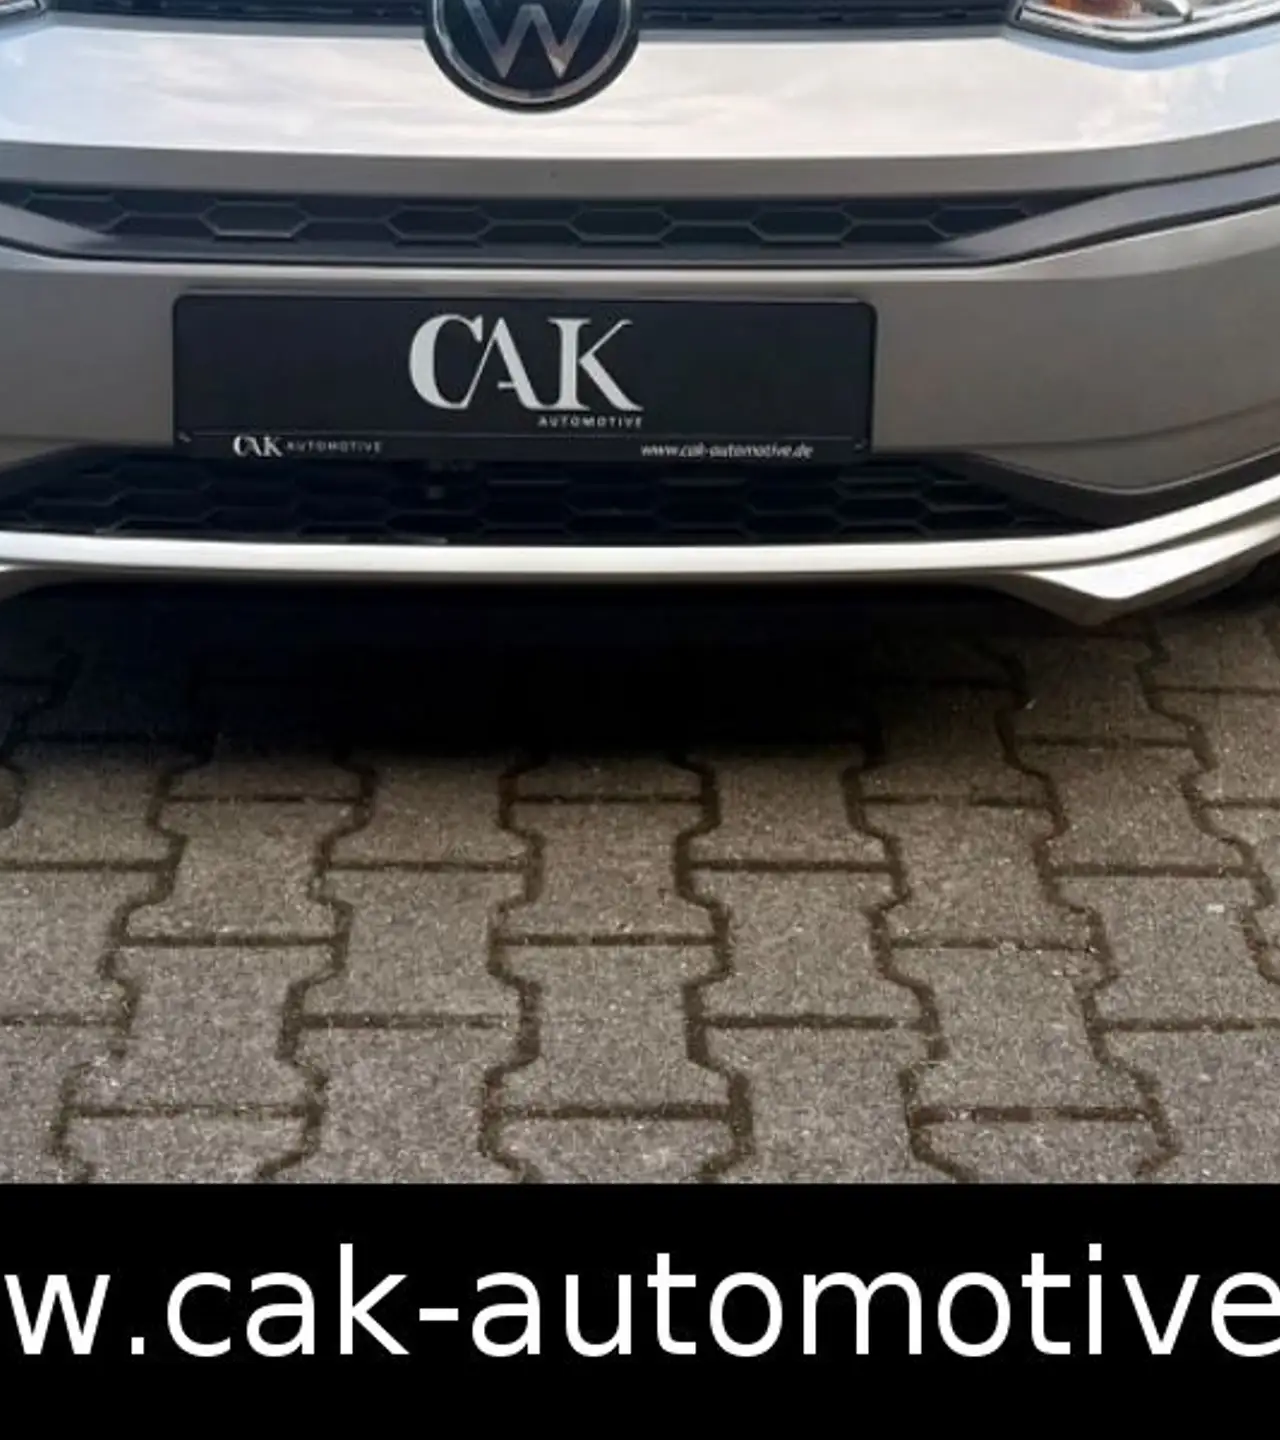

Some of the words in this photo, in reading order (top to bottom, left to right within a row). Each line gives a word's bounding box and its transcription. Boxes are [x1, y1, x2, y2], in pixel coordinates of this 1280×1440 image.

[408, 313, 643, 411] CAK
[537, 415, 643, 428] AUTOMOTIVE
[232, 435, 283, 457] CAK
[286, 440, 383, 453] AUTOMOTIVE
[640, 441, 815, 459] www.cak-automotive.de
